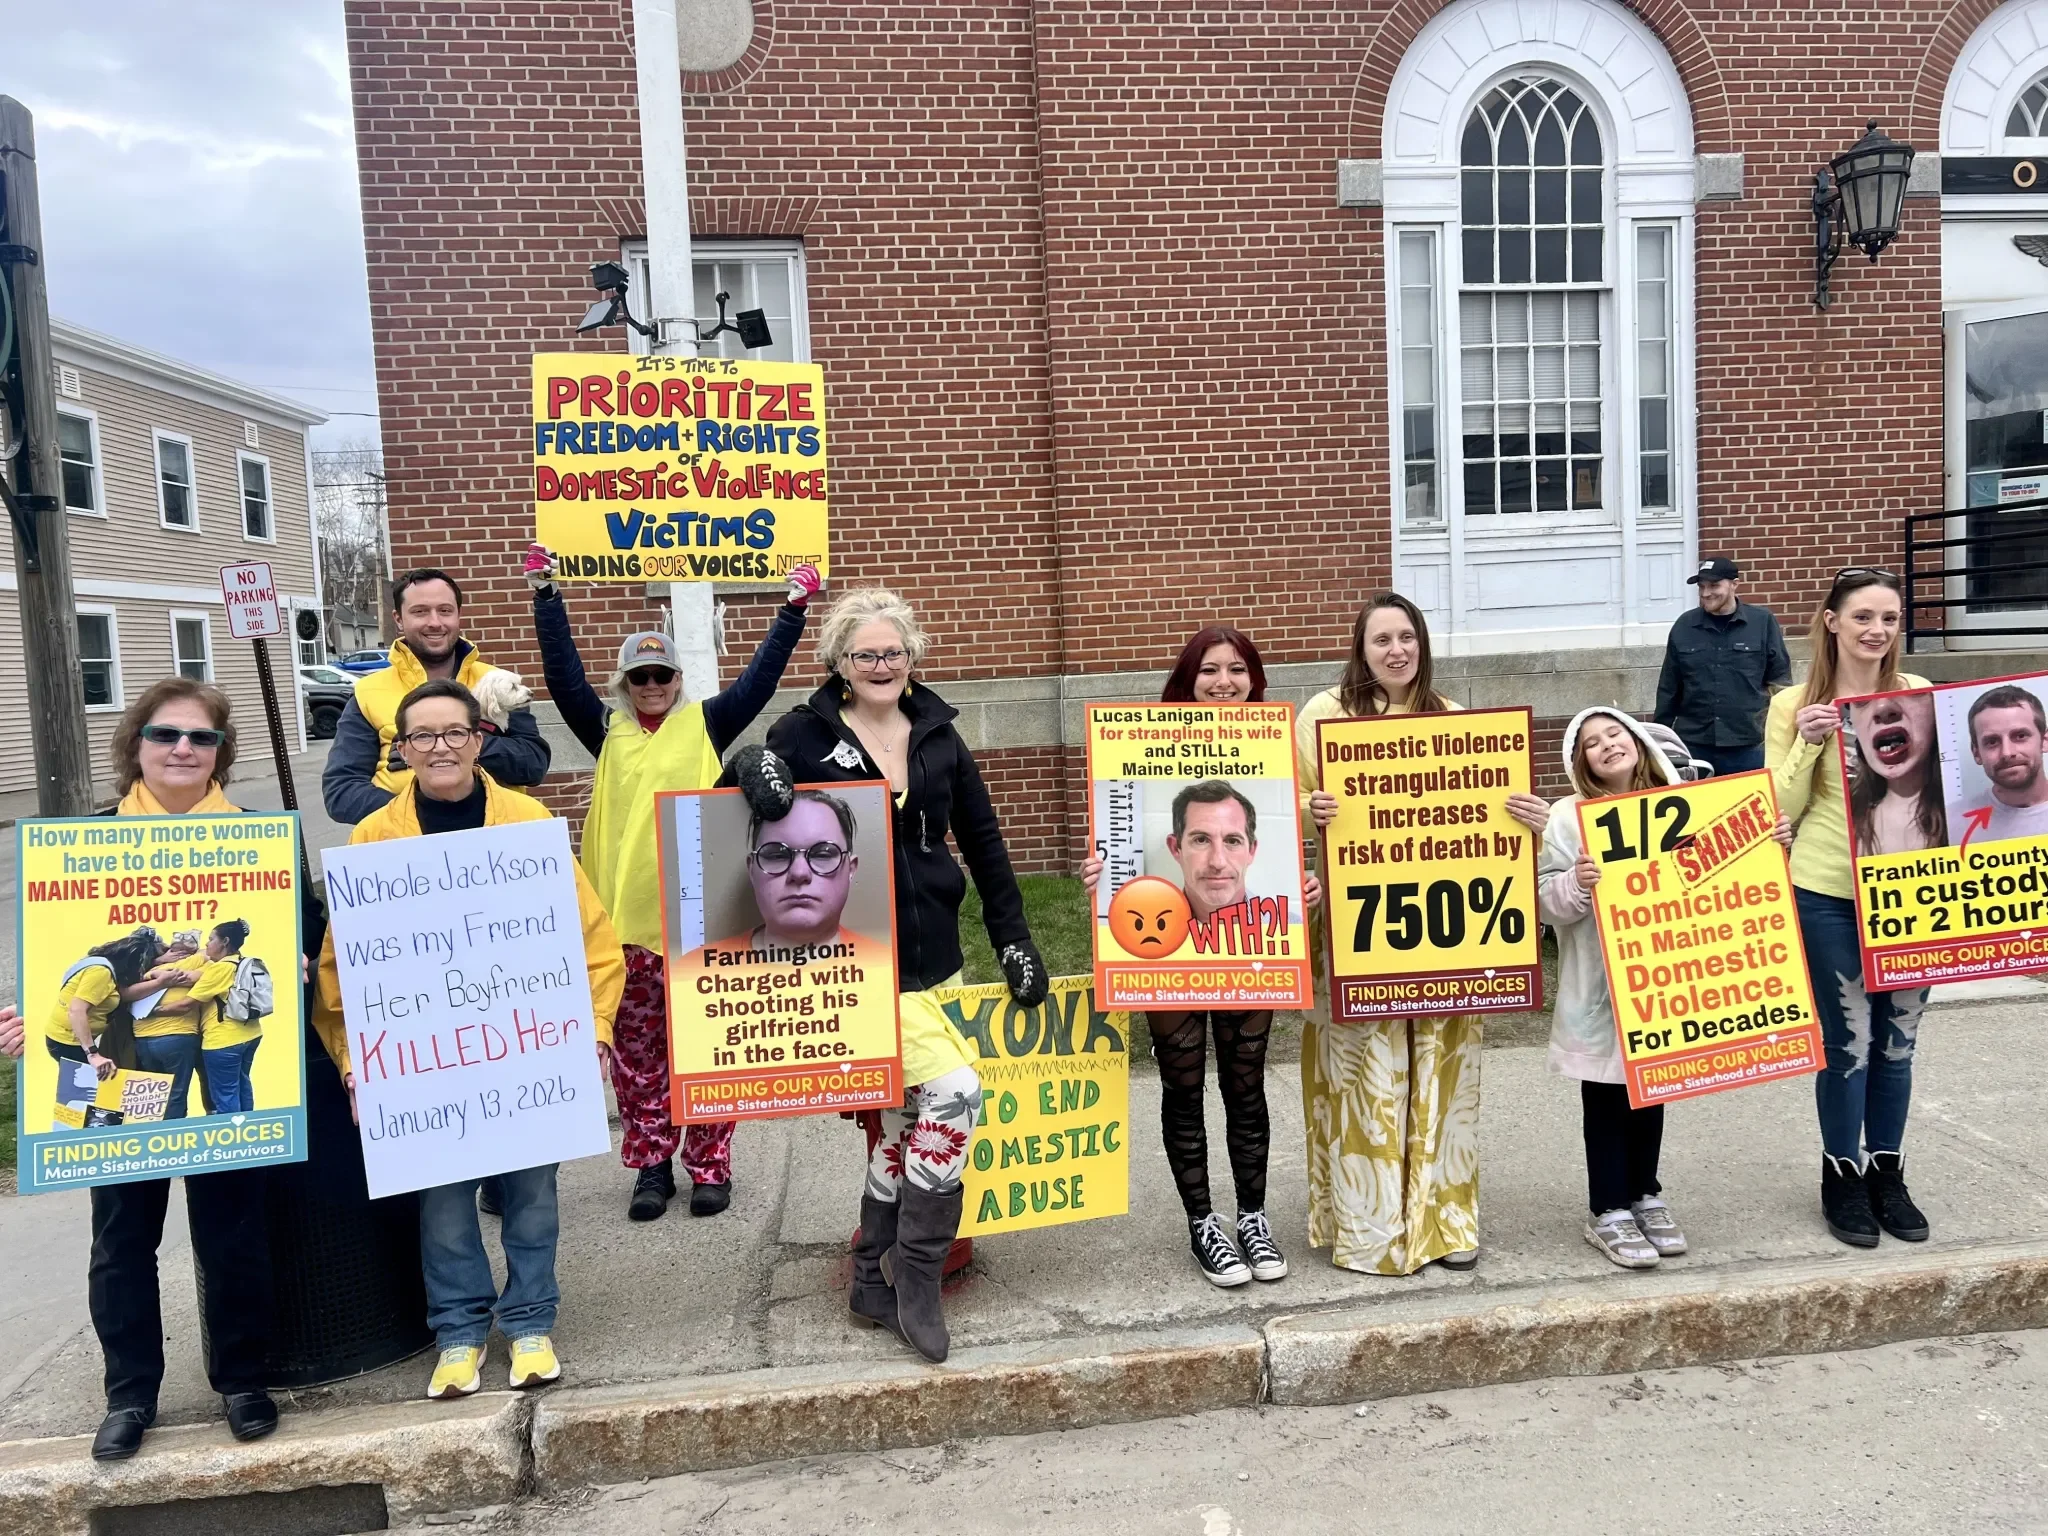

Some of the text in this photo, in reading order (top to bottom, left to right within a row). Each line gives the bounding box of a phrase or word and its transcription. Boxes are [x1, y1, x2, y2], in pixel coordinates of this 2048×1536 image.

[2012, 161, 2037, 188] O
[636, 356, 676, 372] IT'S
[680, 358, 716, 374] TIME
[536, 420, 680, 456] FREEDOM
[682, 428, 694, 442] +
[678, 453, 702, 466] OF
[237, 571, 256, 585] NO
[227, 588, 273, 605] PARKING
[244, 607, 262, 617] THIS
[247, 620, 265, 630] SIDE
[1093, 708, 1287, 726] Lucas Lanigan indicted
[1100, 724, 1282, 742] for strangling his wife
[1326, 732, 1524, 763] Domestic Violence
[1144, 744, 1240, 758] and STILL a
[1122, 761, 1264, 779] Maine legislator!
[1344, 764, 1510, 798] strangulation
[1127, 803, 1134, 812] 4
[1128, 792, 1133, 800] 5
[1369, 803, 1488, 830] increases
[1595, 795, 1696, 862] 1/2
[29, 820, 289, 849] How many more women
[1338, 832, 1522, 866] risk of death by
[1674, 796, 1774, 884] SHAME
[63, 846, 258, 873] have to die before
[1096, 840, 1108, 861] 5
[1626, 860, 1662, 896] of
[1862, 857, 1960, 884] Franklin
[28, 870, 291, 902] MAINE DOES SOMETHING
[1870, 886, 1902, 911] In
[108, 900, 218, 925] ABOUT IT?
[1347, 876, 1525, 953] 750%
[1610, 880, 1781, 932] homicides
[1868, 900, 2048, 939] for 2 hour
[346, 906, 556, 968] was my Friend
[1187, 895, 1290, 956] WTH?!
[1617, 912, 1785, 960] in Maine are
[704, 942, 855, 968] Farmington:
[1625, 940, 1788, 993] Domestic
[1880, 951, 1953, 972] FINDING
[1958, 944, 1996, 962] OUR
[696, 964, 864, 995] Charged with
[1112, 972, 1294, 989] FINDING OUR VOICES
[1883, 969, 1922, 982] Maine
[1924, 960, 1990, 976] Sisterhood
[1993, 958, 2006, 970] of
[364, 957, 572, 1024] Her Boyfriend
[706, 989, 858, 1018] shooting his
[1114, 988, 1295, 1002] Maine Sisterhood of Survivors
[1348, 977, 1526, 1002] FINDING OUR VOICES
[1350, 994, 1526, 1014] Maine Sisterhood of Survivors
[1631, 974, 1794, 1024] Violence.
[726, 1014, 840, 1046] girlfriend
[1628, 1002, 1809, 1054] For Decades.
[358, 1008, 580, 1084] KILLED Her
[714, 1040, 854, 1066] in the face.
[1642, 1038, 1808, 1084] FINDING OUR VOICES
[690, 1070, 884, 1102] FINDING OUR VOICES
[1646, 1056, 1810, 1096] Maine Sisterhood of Survivors
[120, 1101, 166, 1116] HURT
[368, 1075, 576, 1142] January 13, 2026
[692, 1089, 884, 1114] Maine Sisterhood of Survivors
[977, 1080, 1100, 1126] TO END
[44, 1122, 285, 1165] FINDING OUR VOICES
[963, 1121, 1121, 1172] OMESTIC
[44, 1142, 284, 1180] Maine Sisterhood of Survivors
[976, 1174, 1085, 1223] ABUSE
